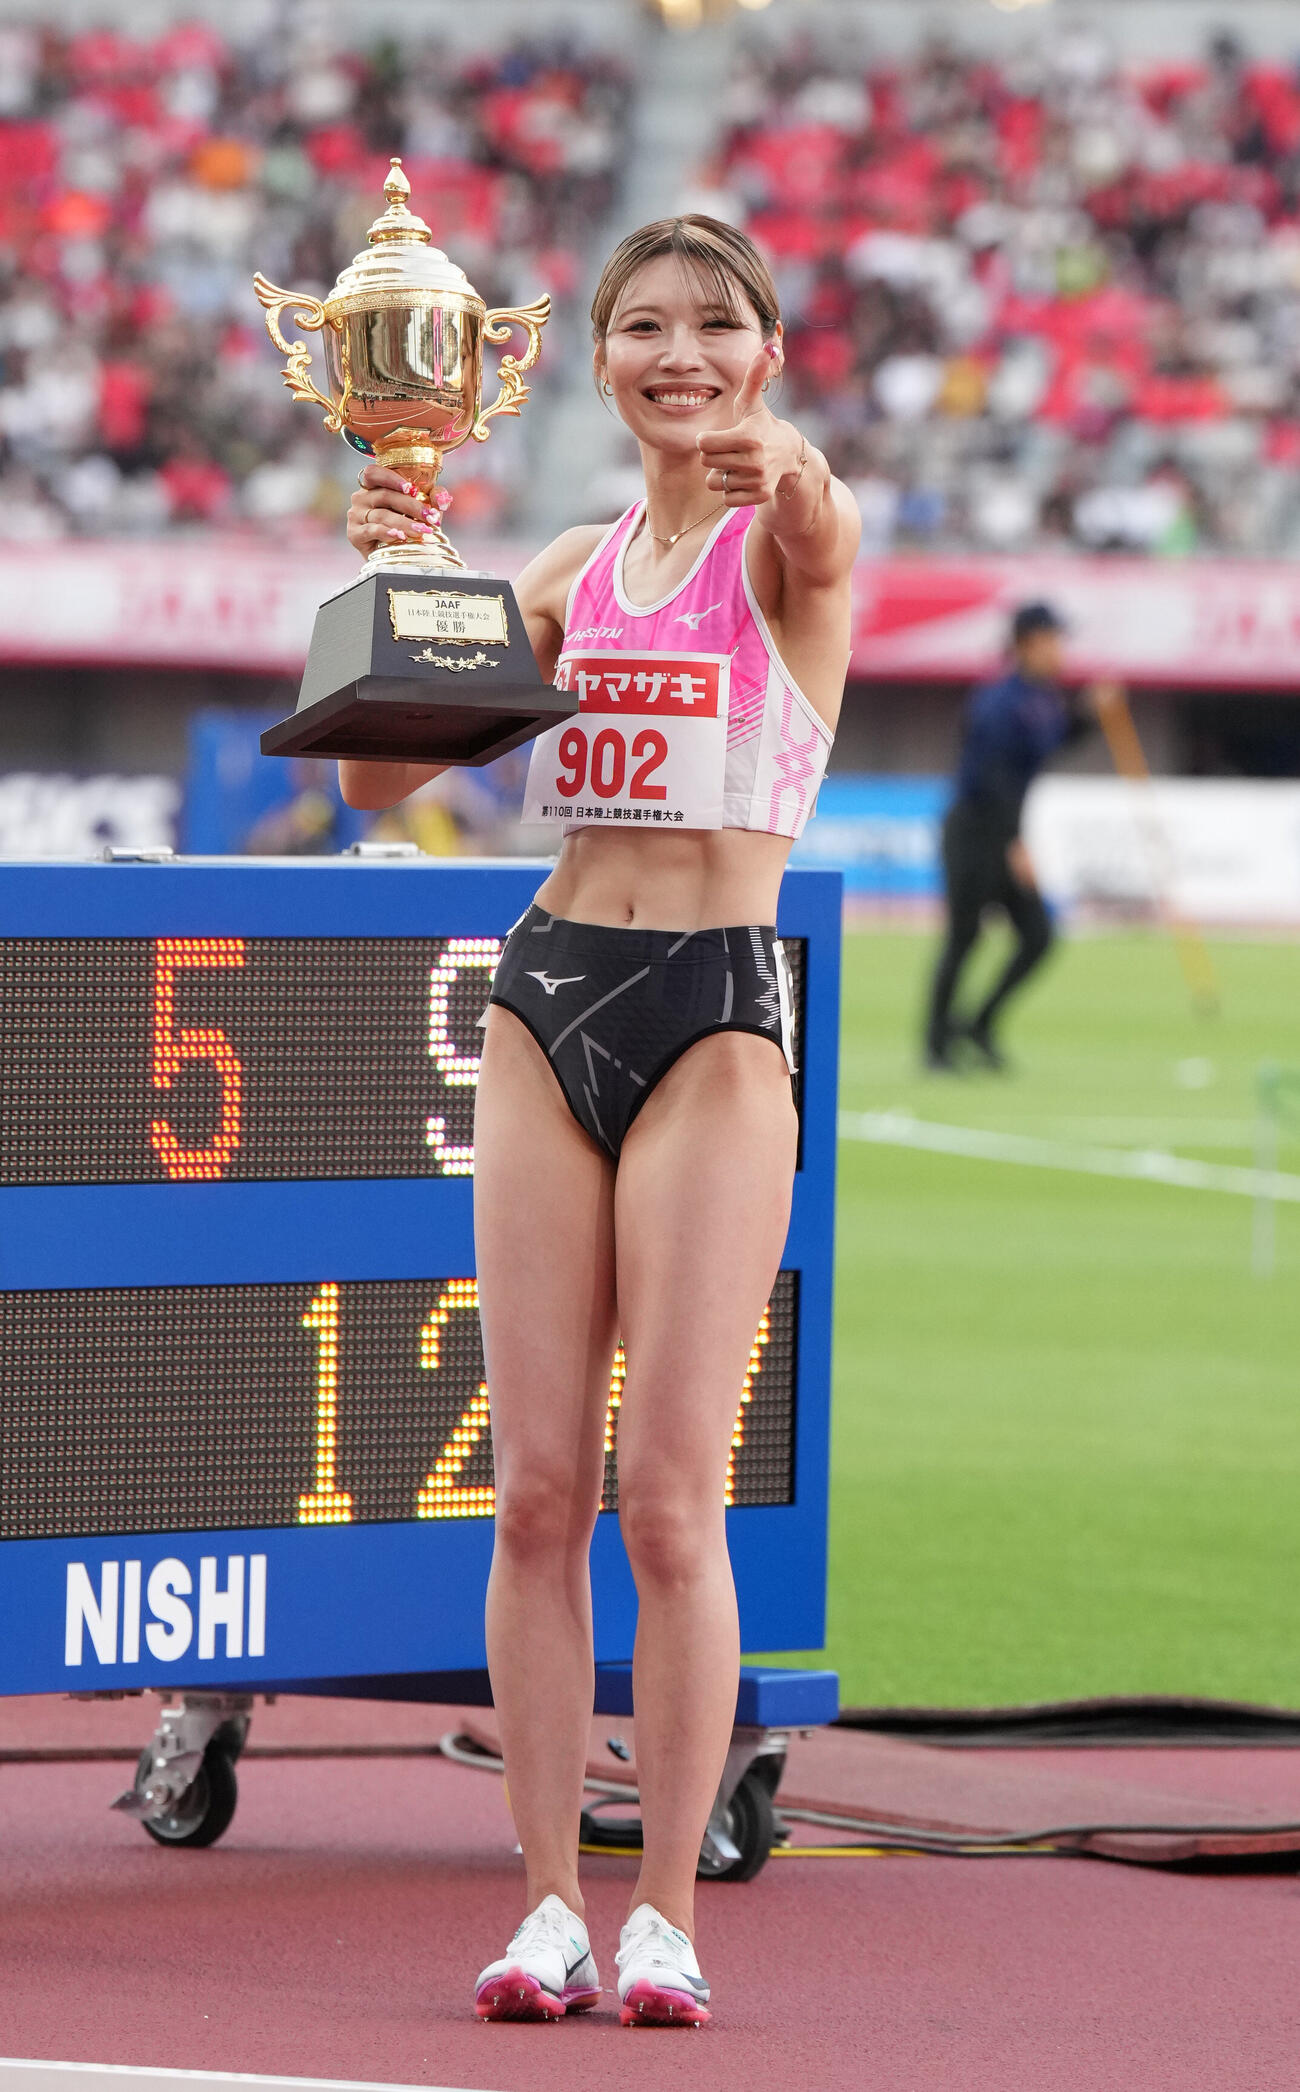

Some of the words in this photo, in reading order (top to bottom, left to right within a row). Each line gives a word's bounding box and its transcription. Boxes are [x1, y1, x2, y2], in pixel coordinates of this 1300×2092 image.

[407, 608, 491, 621] 日本陸上競技選手権大会
[435, 599, 461, 609] JAAF
[436, 619, 467, 633] 優勝
[575, 670, 707, 705] ヤマザキ
[556, 727, 669, 801] 902
[541, 806, 573, 818] 第110回
[576, 806, 685, 822] 日本陸上競技選手権大会
[152, 938, 245, 1179] 5
[65, 1554, 267, 1666] NISHI
